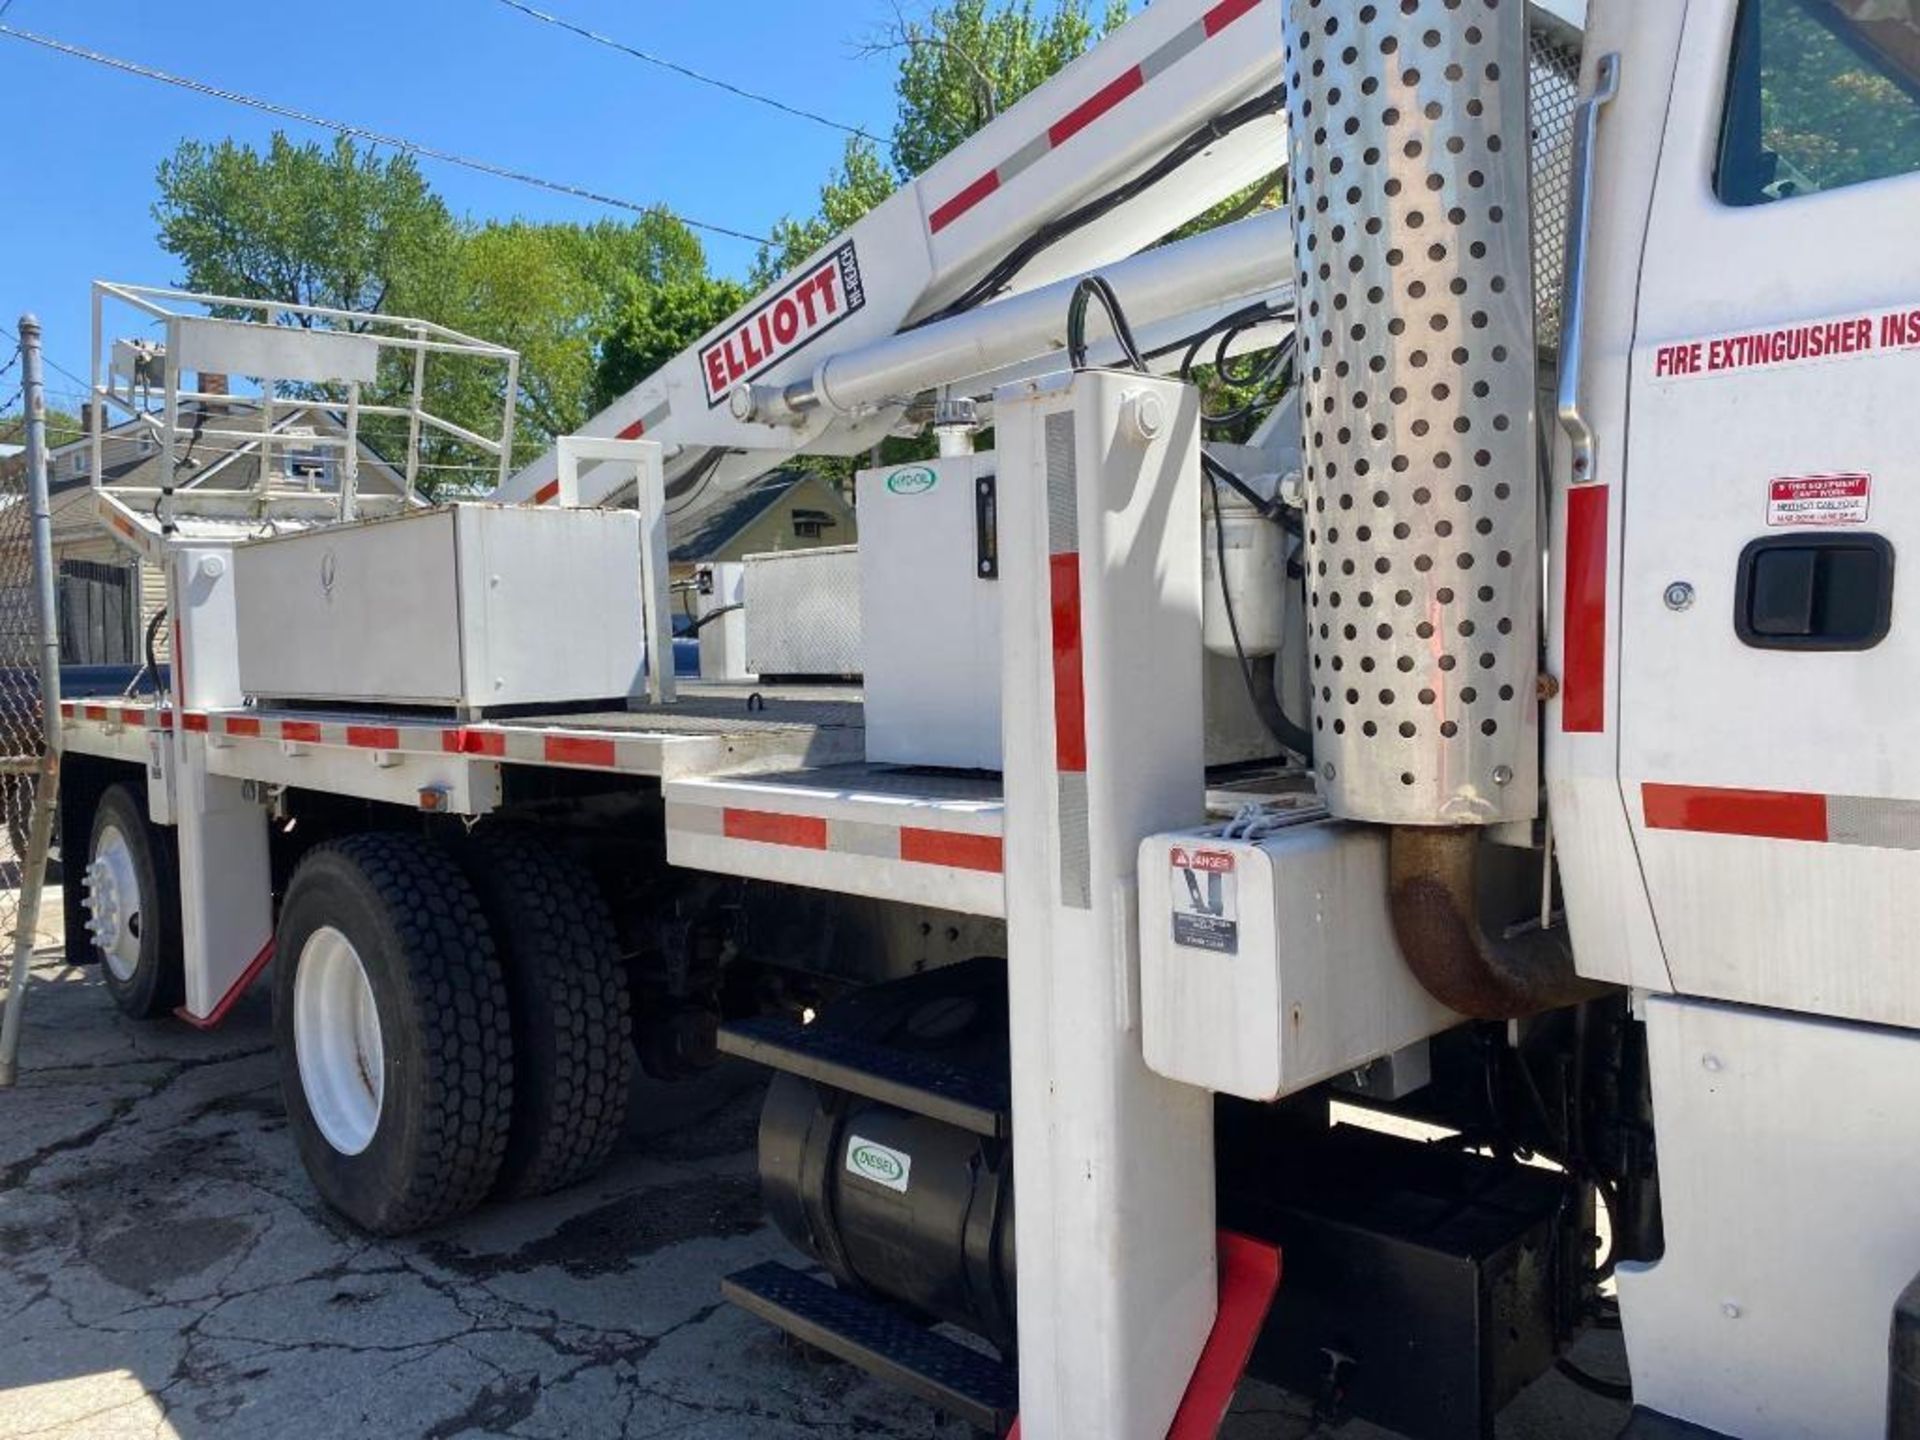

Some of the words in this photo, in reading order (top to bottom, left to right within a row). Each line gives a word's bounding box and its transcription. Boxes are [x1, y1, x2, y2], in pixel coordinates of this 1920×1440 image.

[841, 246, 863, 308] HI-REACH
[706, 265, 837, 394] ELLIOTT
[1656, 343, 1702, 377] FIRE
[1708, 318, 1872, 370] EXTINGUISHER
[860, 1151, 894, 1174] DIESEL
